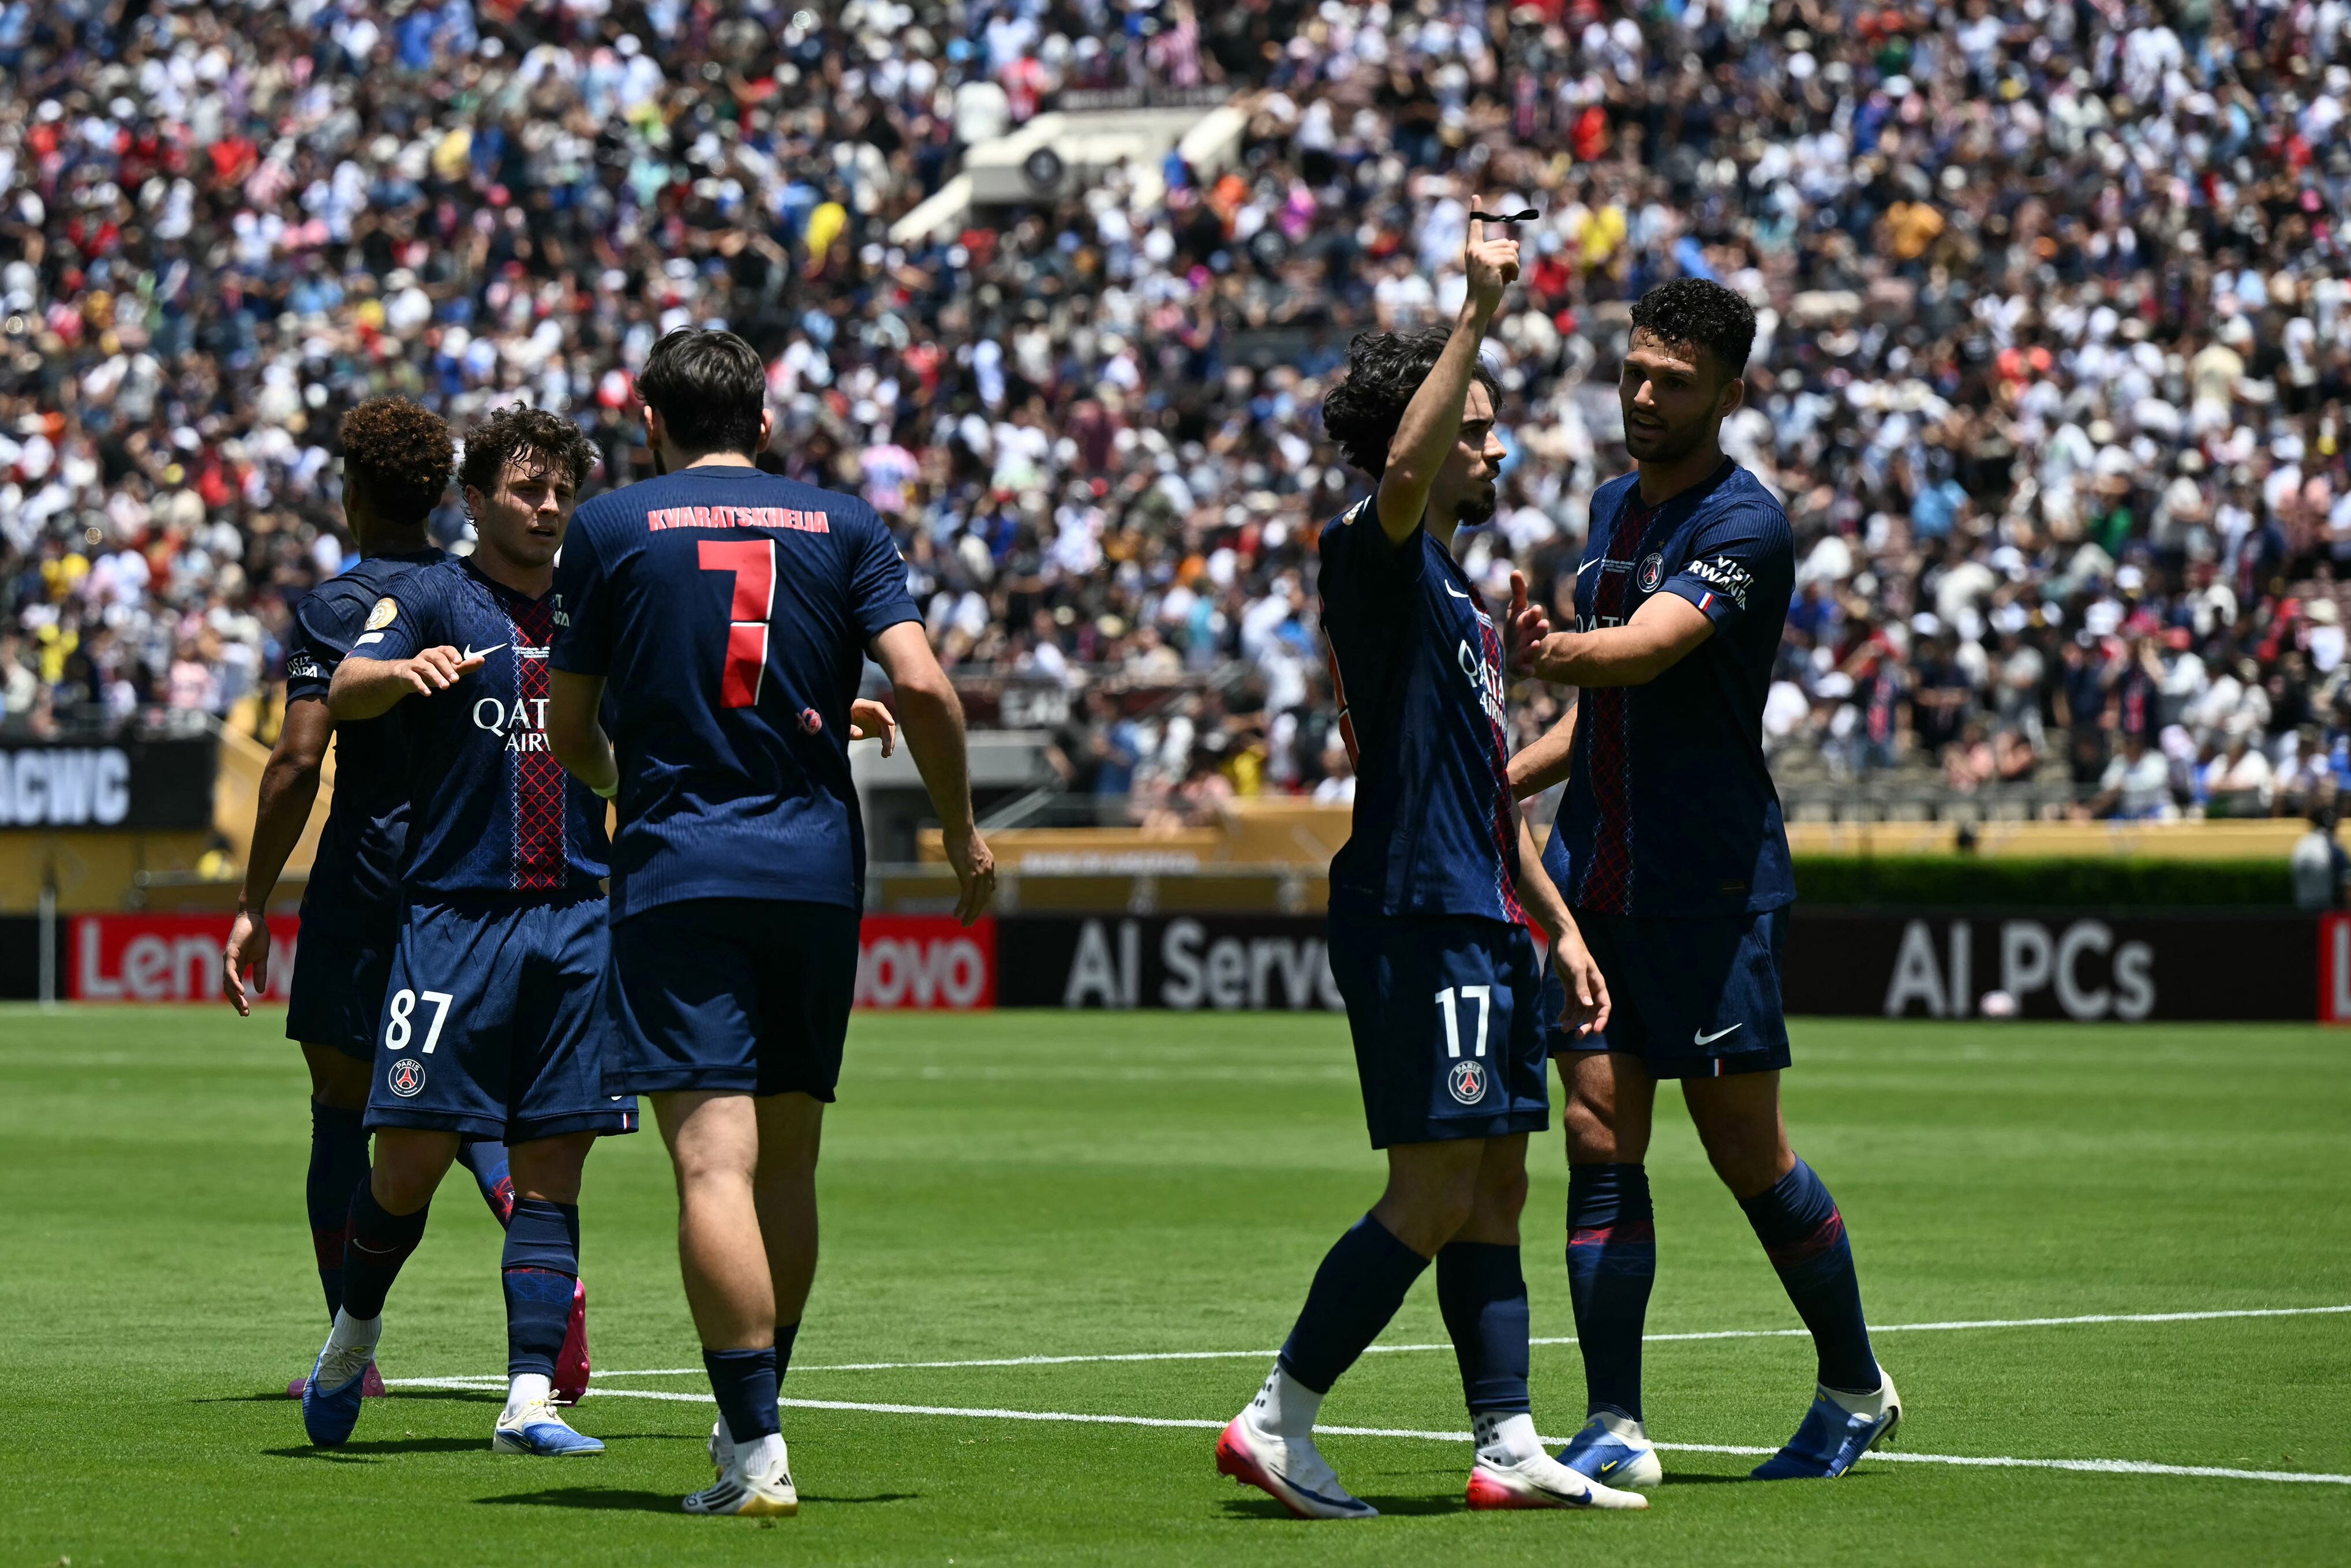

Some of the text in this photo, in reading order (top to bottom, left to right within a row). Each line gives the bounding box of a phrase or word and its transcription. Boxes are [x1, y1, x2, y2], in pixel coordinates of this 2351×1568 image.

[647, 506, 830, 533] KVARATSKHELIA
[1688, 560, 1746, 611] RWANDA
[1718, 555, 1754, 589] VISIT
[698, 539, 776, 709] 7
[473, 698, 551, 737] QAT
[1884, 918, 2157, 1020] AI PCs
[385, 989, 454, 1054] 87
[1435, 985, 1490, 1058] 17
[396, 1061, 420, 1071] PARIS
[1455, 1062, 1481, 1074] PARIS
